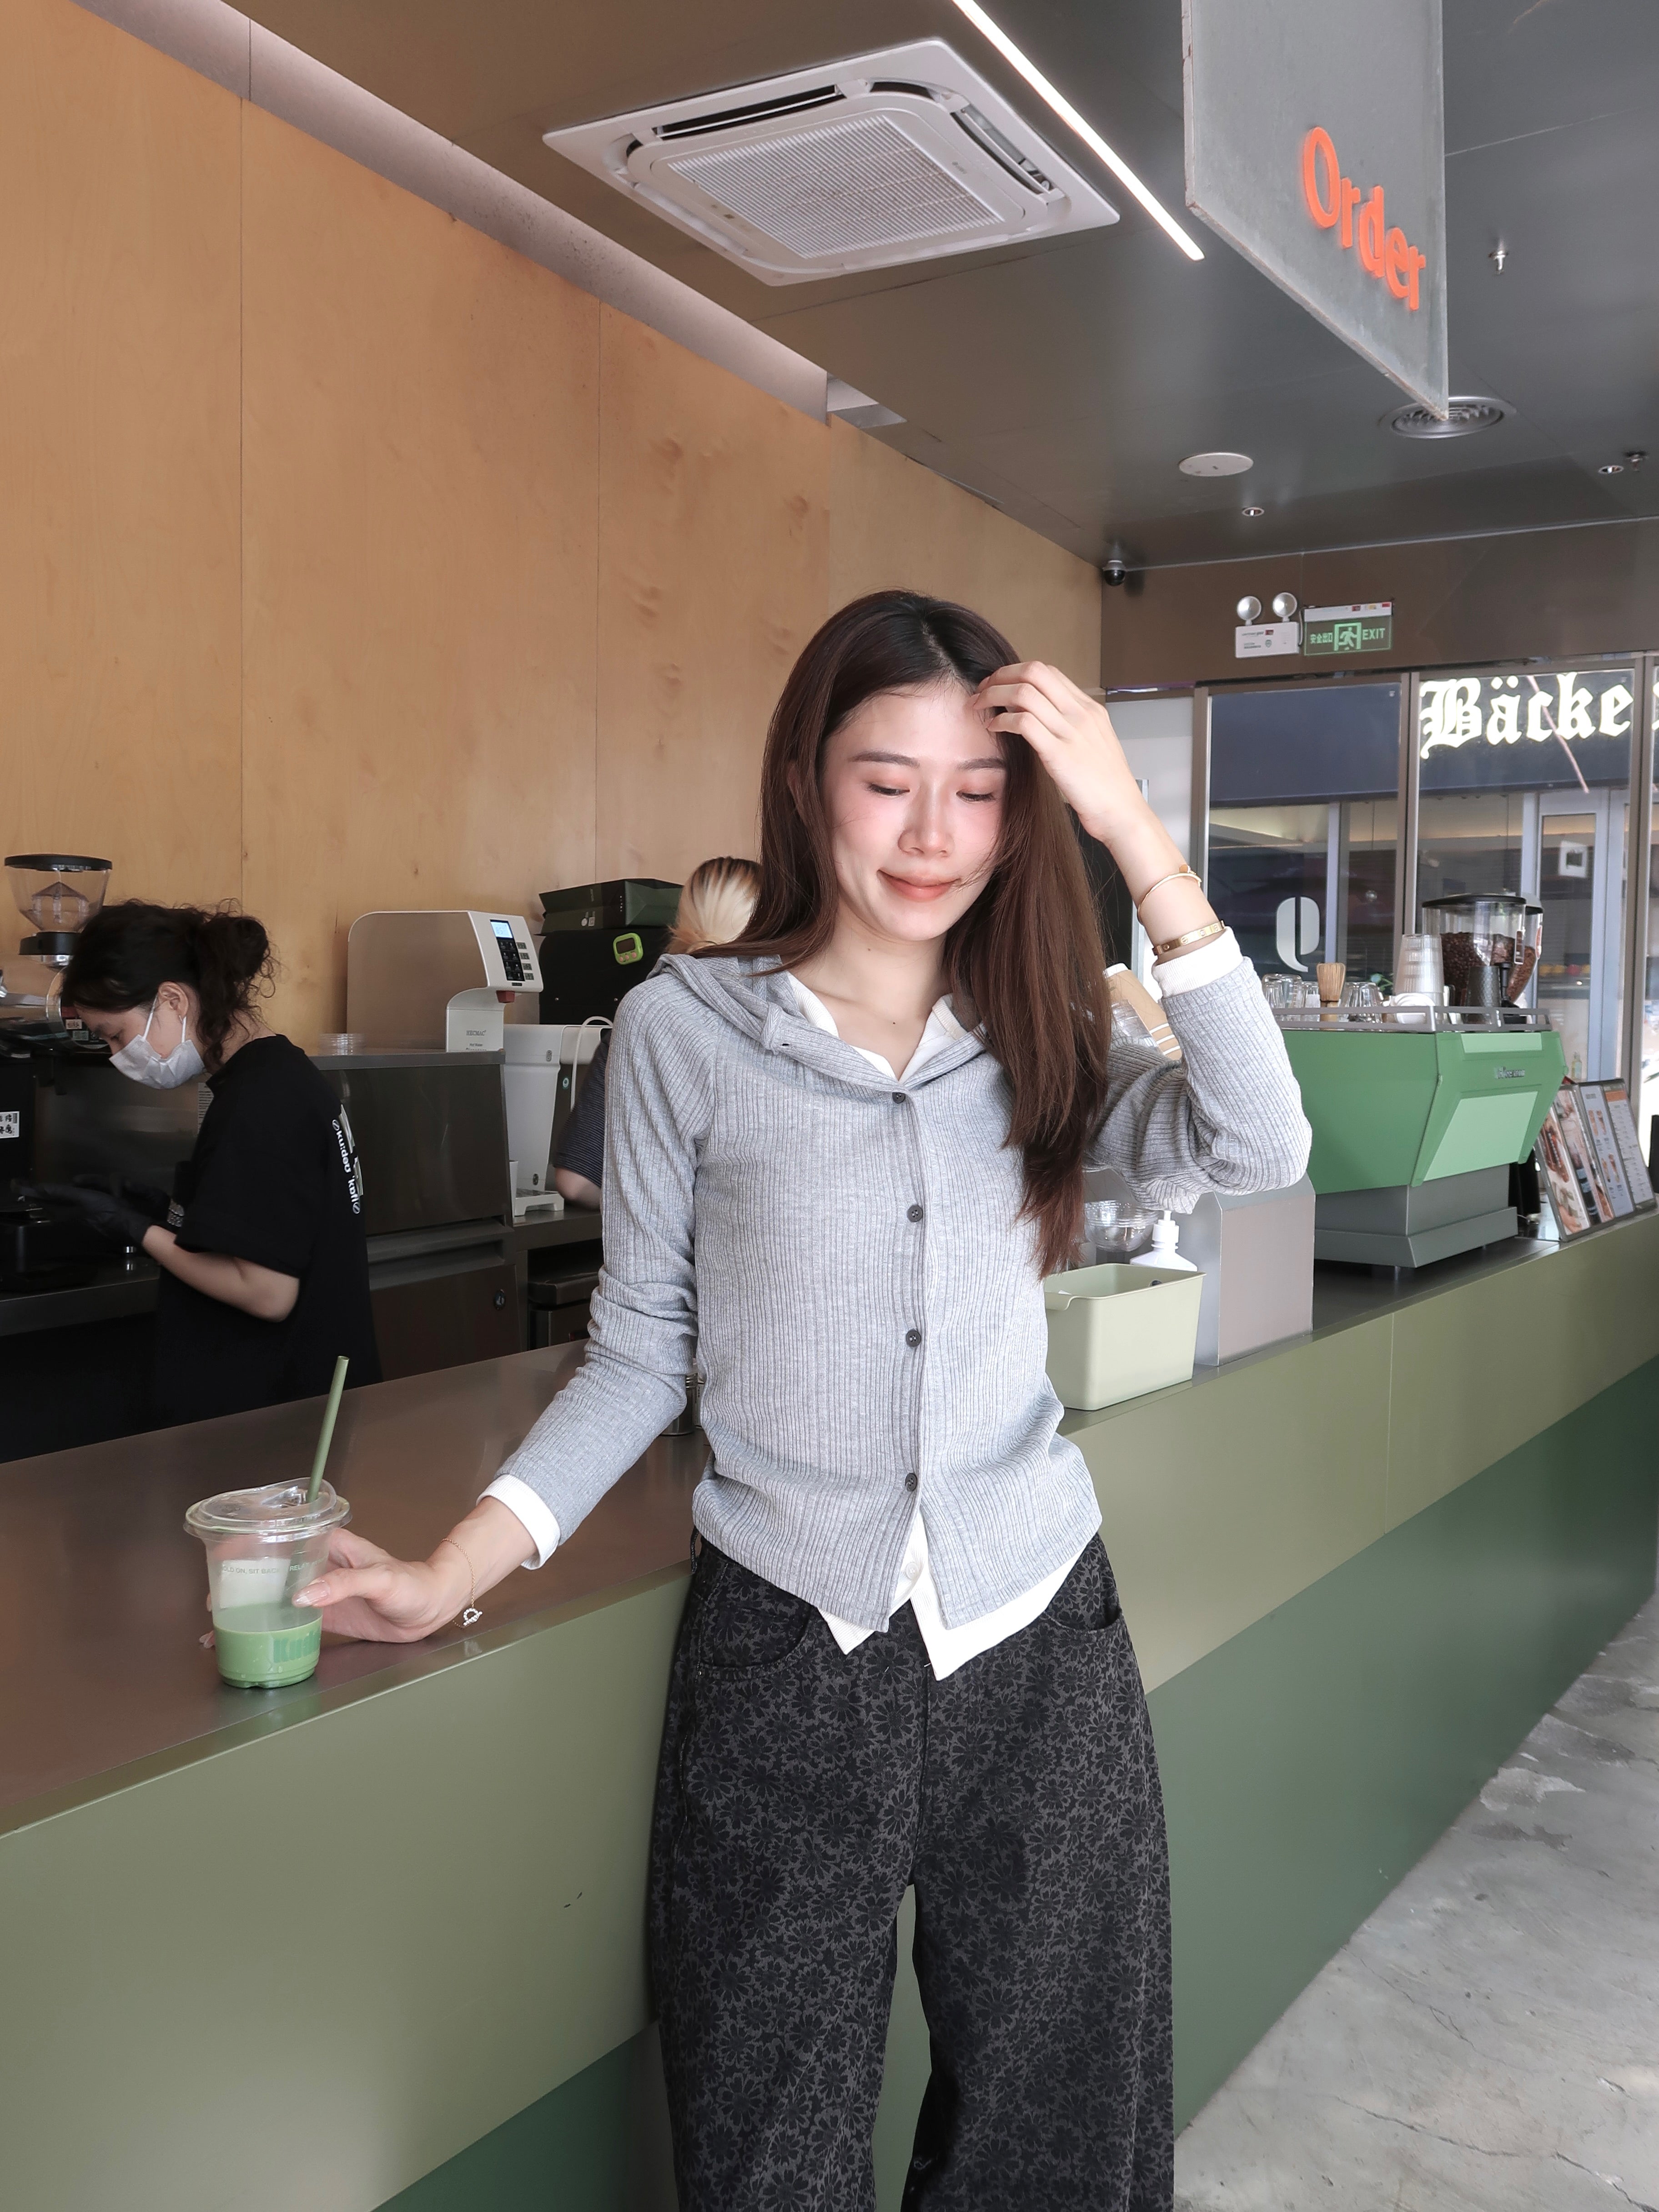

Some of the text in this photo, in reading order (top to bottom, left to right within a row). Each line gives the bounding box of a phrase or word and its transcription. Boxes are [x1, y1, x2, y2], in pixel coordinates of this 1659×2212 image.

[1303, 126, 1426, 311] Order
[1310, 632, 1333, 644] 安全出口
[1362, 628, 1385, 640] EXIT
[1419, 672, 1659, 759] Bäcke
